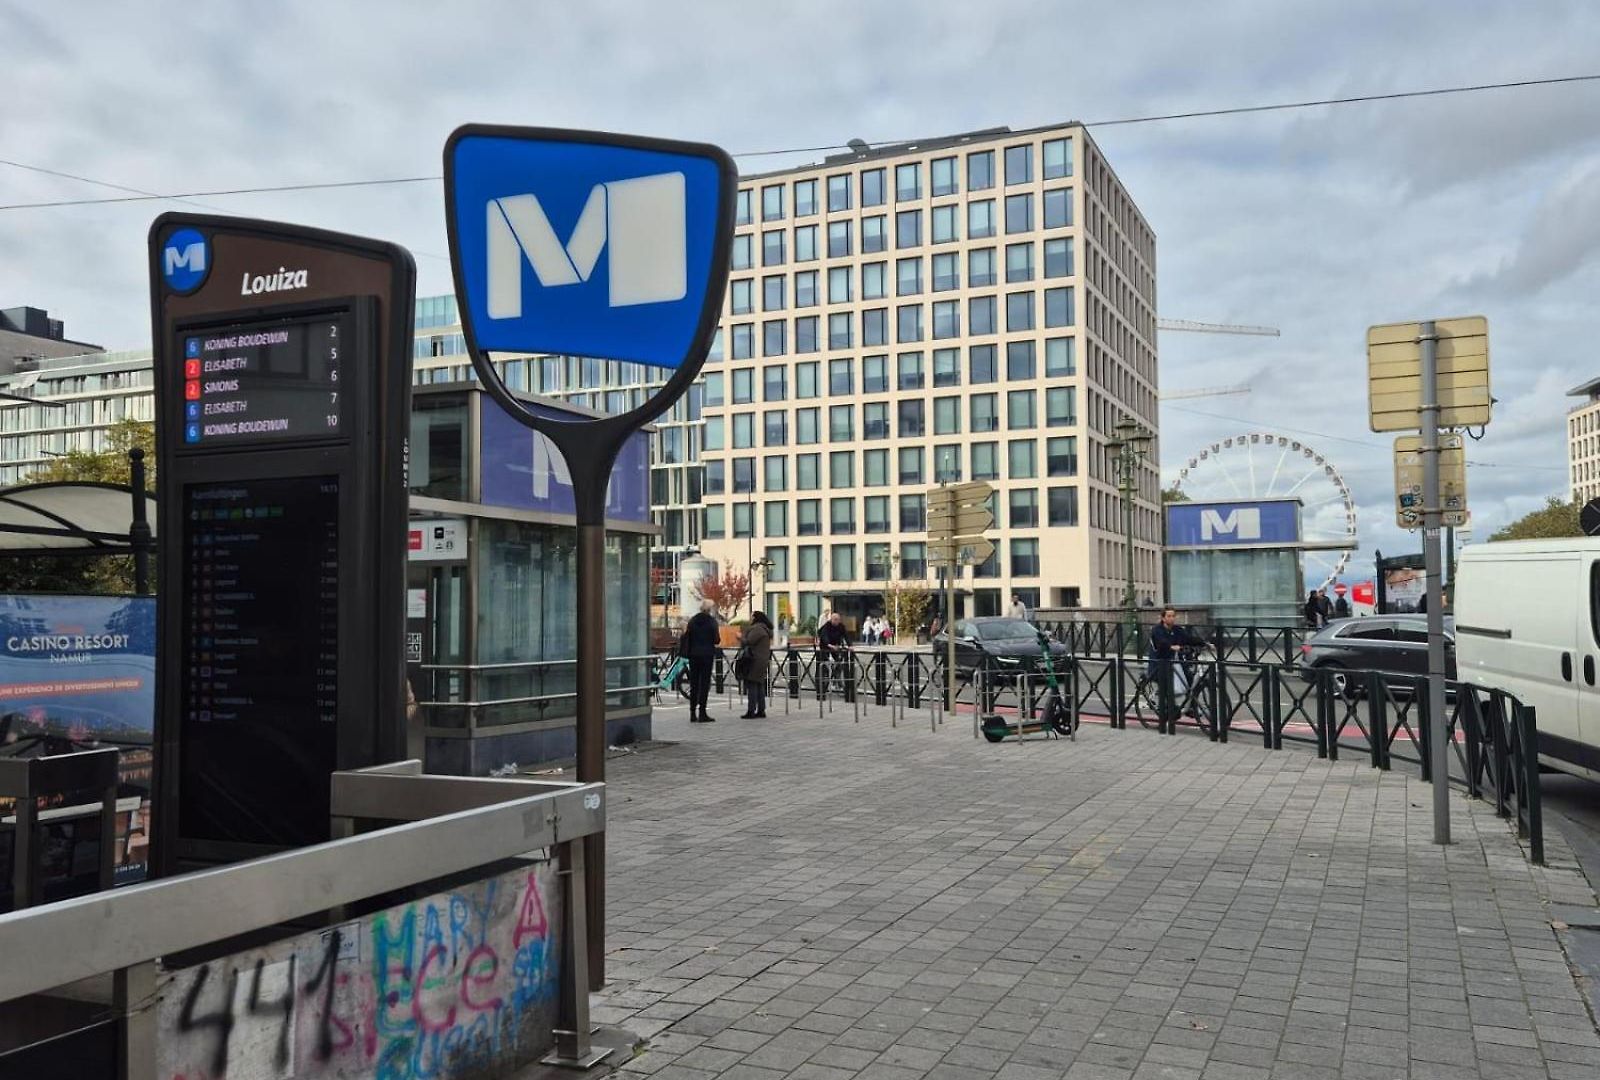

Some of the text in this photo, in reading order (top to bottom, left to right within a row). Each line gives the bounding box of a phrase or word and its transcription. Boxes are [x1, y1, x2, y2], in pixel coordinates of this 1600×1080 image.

[486, 171, 687, 320] M
[165, 242, 205, 276] M
[240, 266, 308, 297] Louiza
[189, 342, 196, 352] 6
[204, 334, 237, 351] KONING
[330, 326, 337, 337] 2
[189, 348, 337, 374] 2 ELISABETH 5
[189, 370, 337, 396] 2 SIMONIS 6
[189, 392, 337, 415] 6 ELISABETH 7
[189, 426, 196, 437] 6
[204, 420, 237, 436] KONING
[326, 415, 338, 426] 10
[1200, 507, 1261, 541] M
[7, 634, 129, 652] CASINO RESORT
[49, 652, 93, 664] NAMUR
